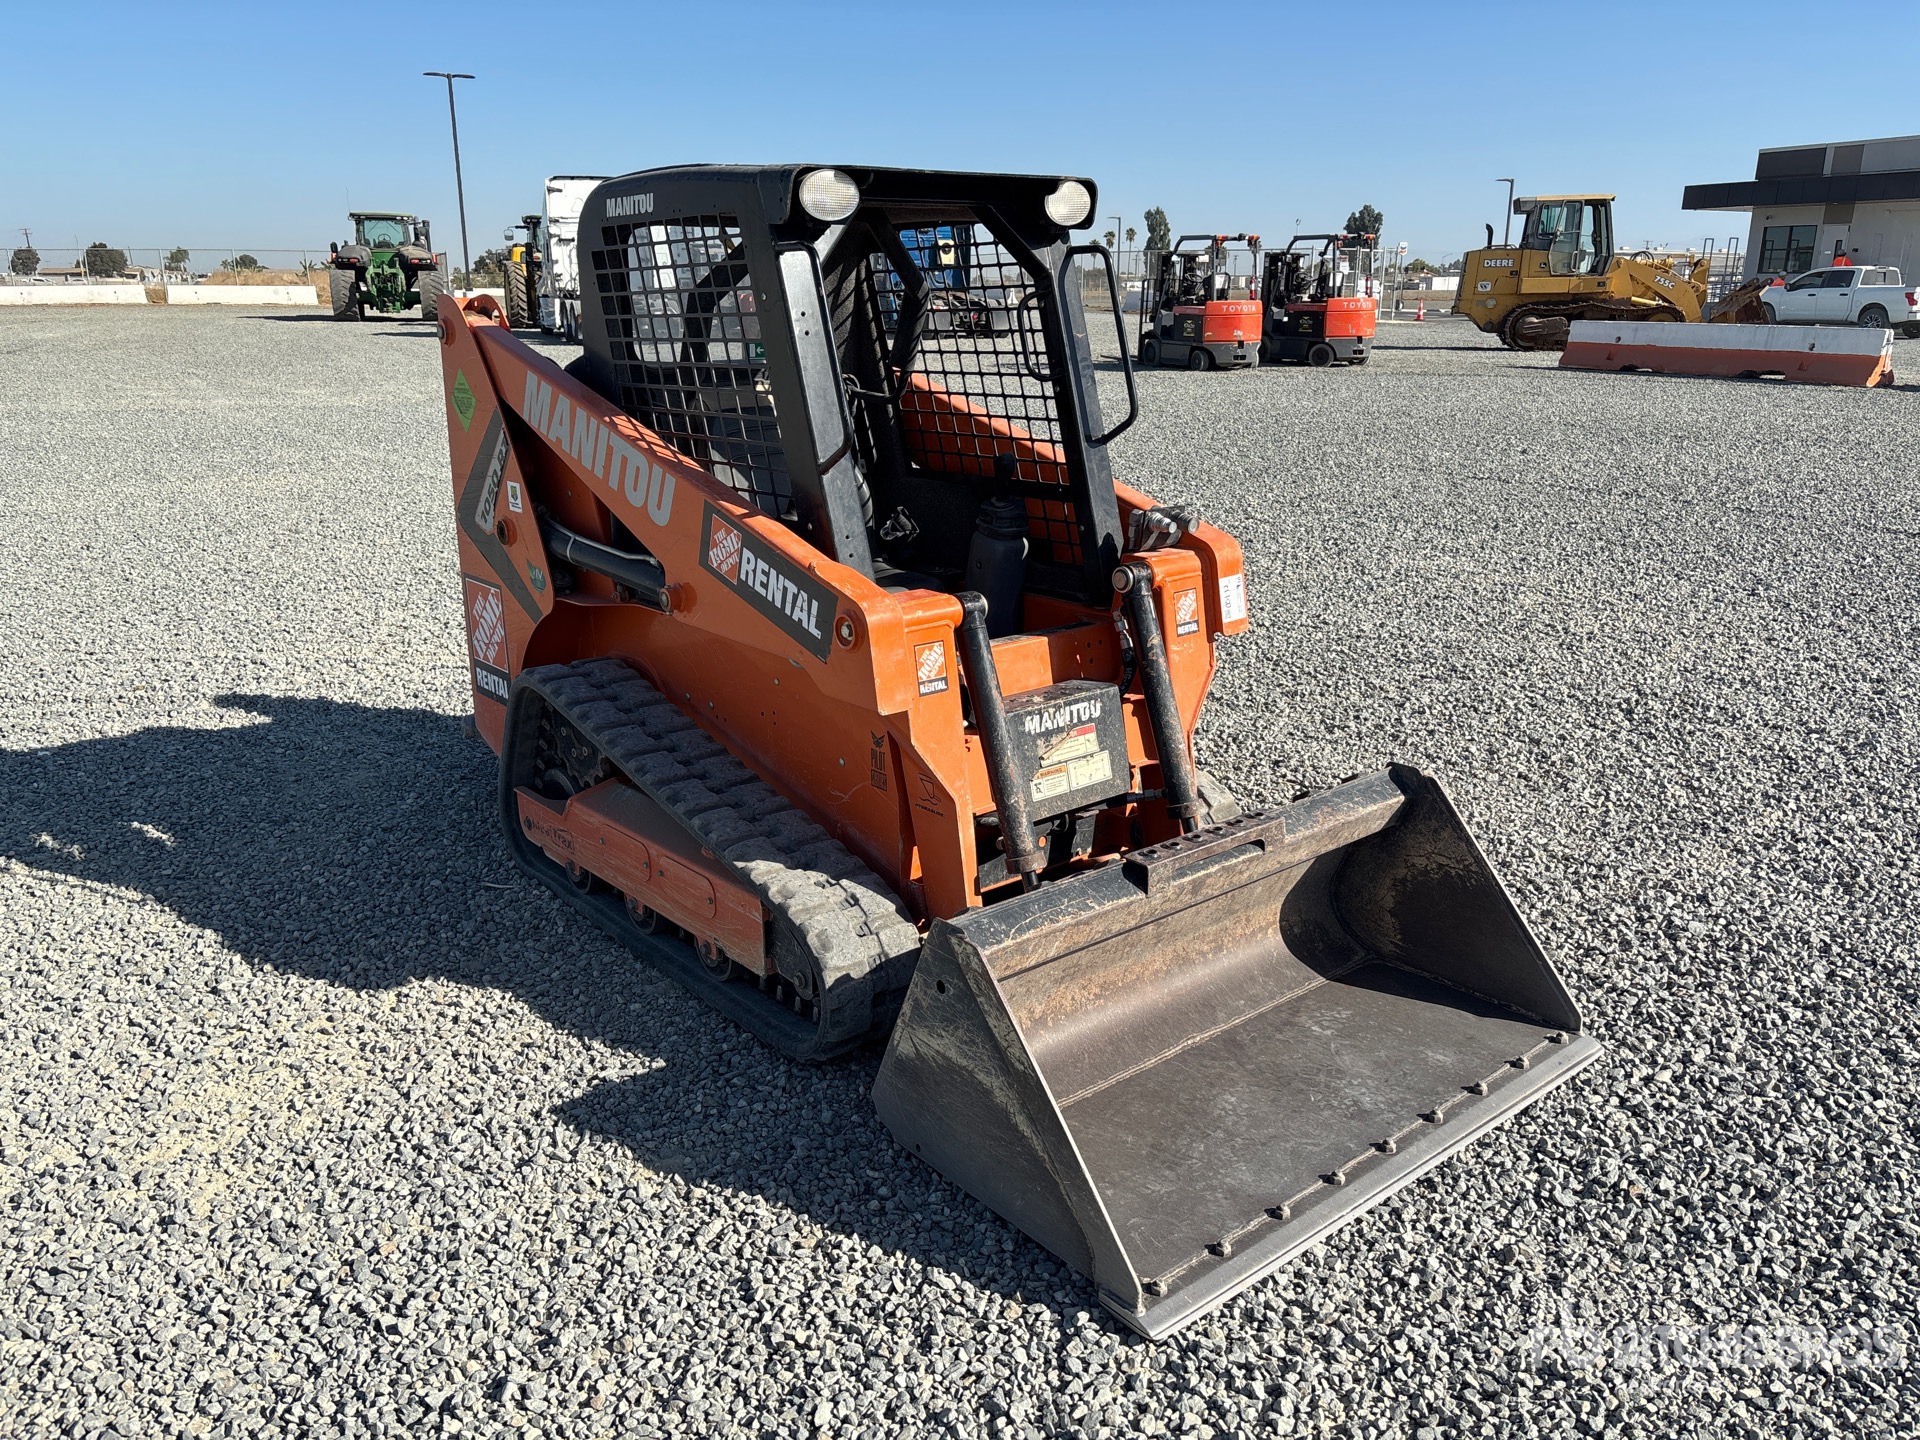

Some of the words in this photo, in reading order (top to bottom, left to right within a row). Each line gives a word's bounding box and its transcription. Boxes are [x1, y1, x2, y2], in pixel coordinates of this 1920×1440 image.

[606, 193, 654, 217] MANITOU
[1483, 259, 1515, 268] DEERE
[1653, 275, 1676, 290] 755C
[1343, 301, 1372, 309] TOYOTA
[523, 370, 676, 527] MANITOU
[481, 468, 500, 524] 1050
[708, 530, 742, 567] HOME
[714, 528, 726, 544] THE
[720, 551, 740, 573] DEPOT
[473, 592, 486, 620] THE
[740, 547, 822, 640] RENTAL
[473, 589, 502, 661] HOME
[1177, 622, 1199, 635] RENTAL
[486, 620, 505, 664] DEPOT
[918, 643, 944, 680] HOME
[919, 648, 931, 663] THE
[920, 680, 948, 694] RENTAL
[1024, 699, 1102, 734] MANITOU
[871, 748, 886, 773] PILOT
